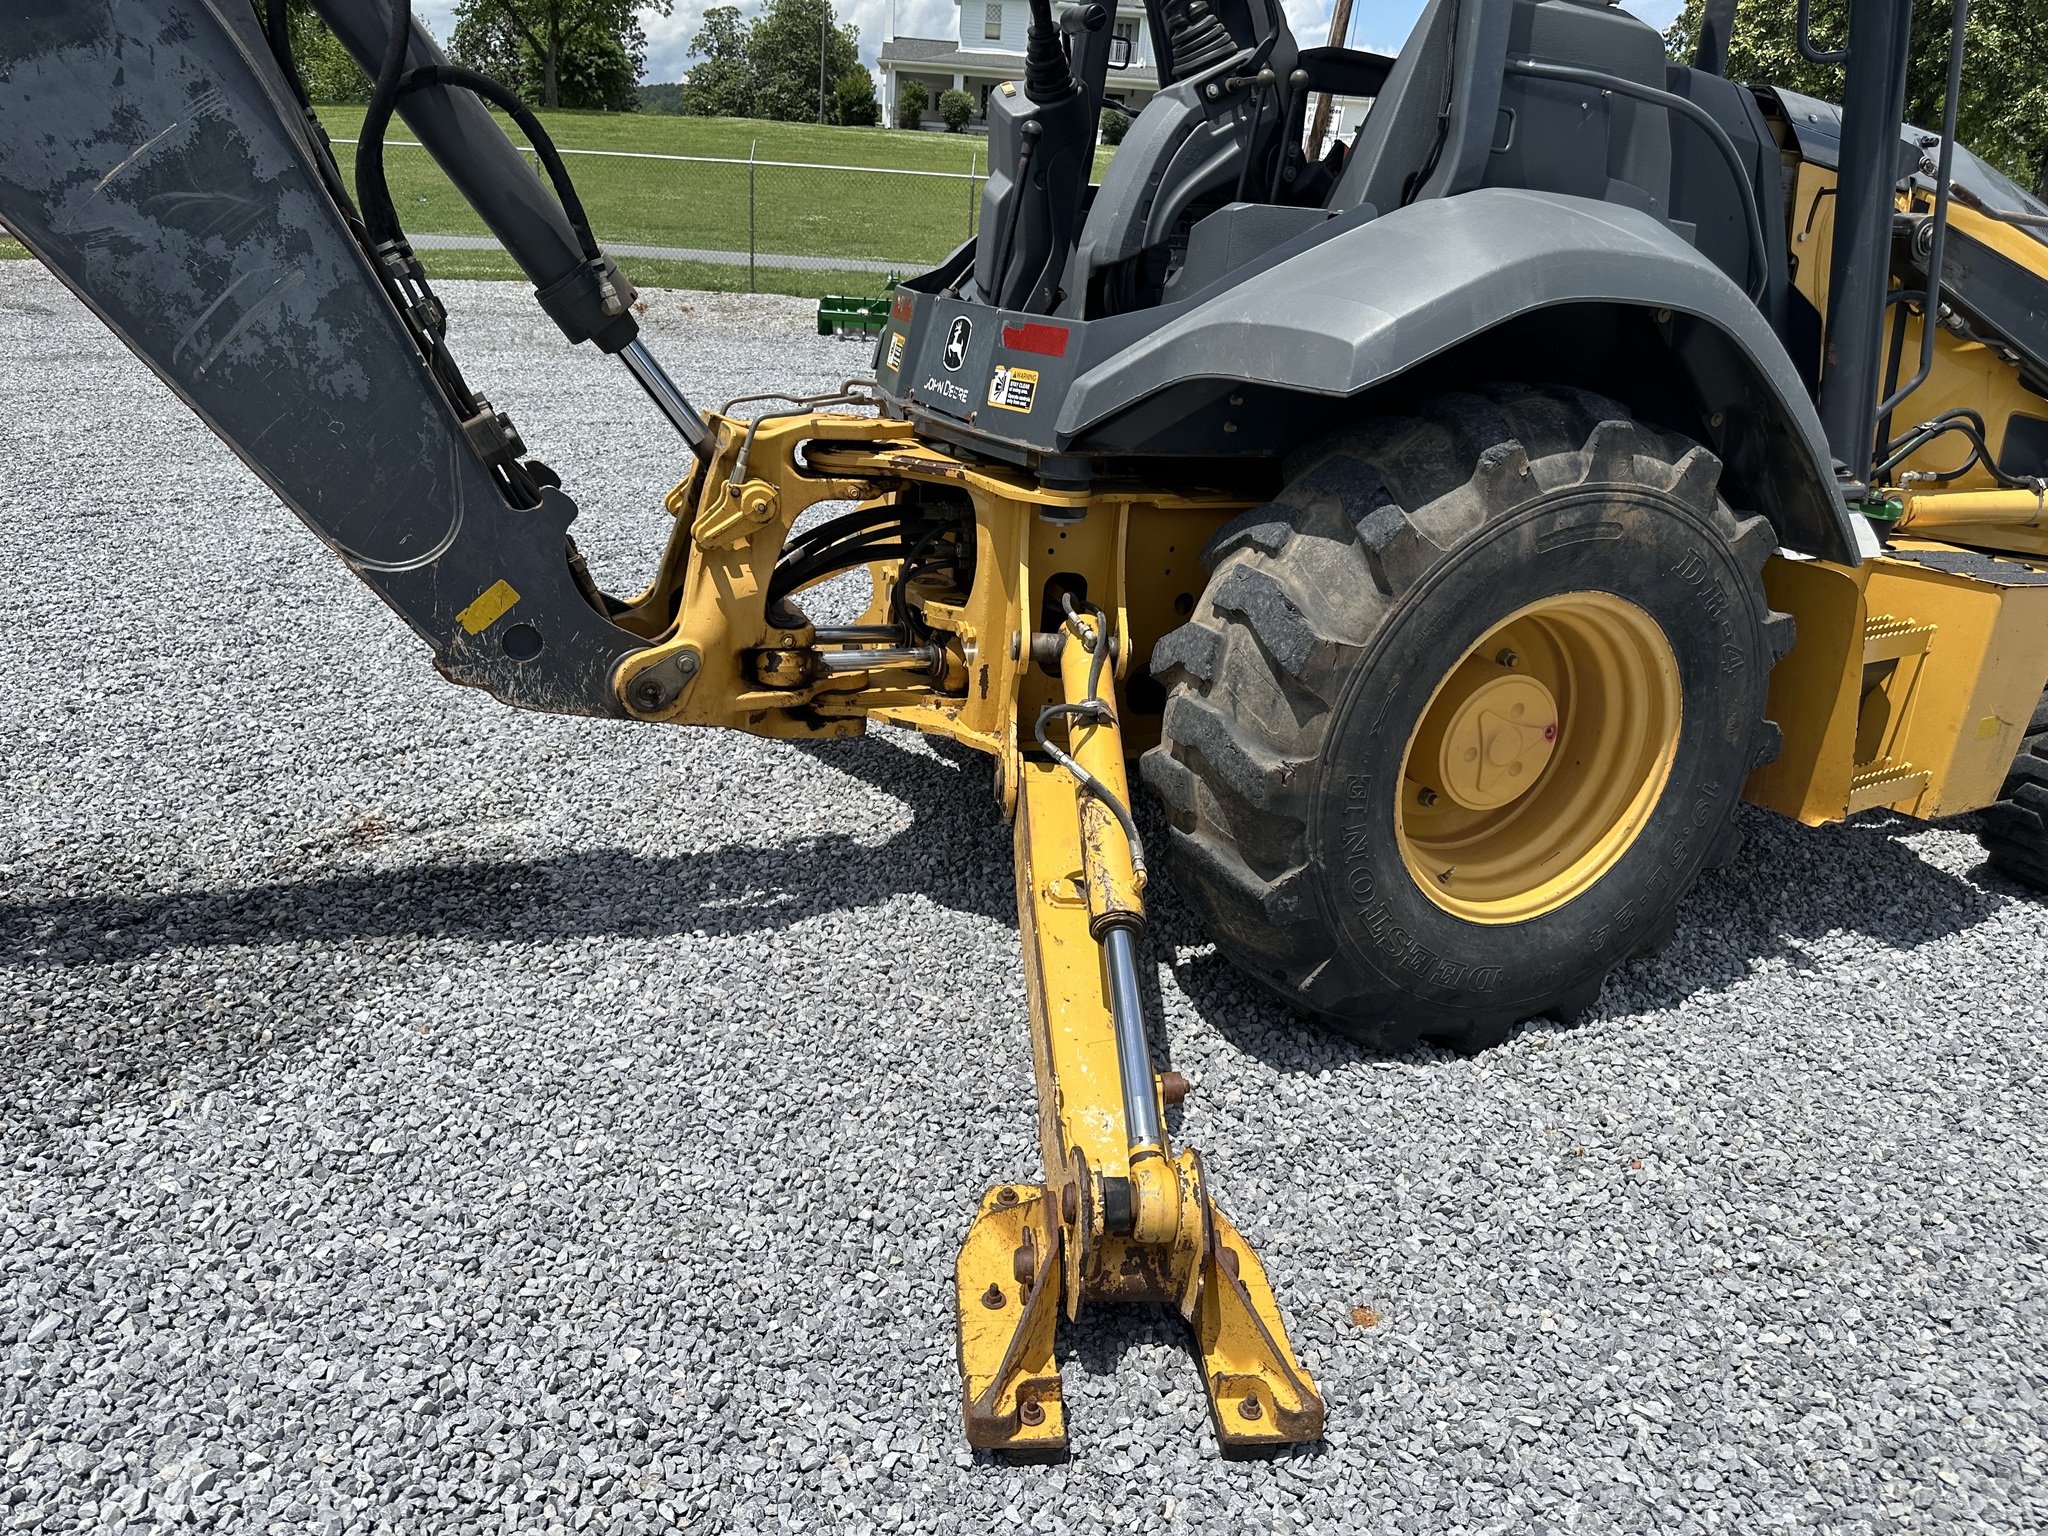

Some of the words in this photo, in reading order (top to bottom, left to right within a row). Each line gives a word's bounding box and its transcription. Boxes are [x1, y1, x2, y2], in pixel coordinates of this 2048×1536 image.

[1010, 380, 1019, 388] STAY
[1018, 382, 1030, 390] CLEAR
[1016, 371, 1037, 382] WARNING
[1670, 547, 1745, 673] DR-4
[1340, 774, 1503, 993] DEESTONE
[1588, 781, 1720, 952] 19.5L-24
